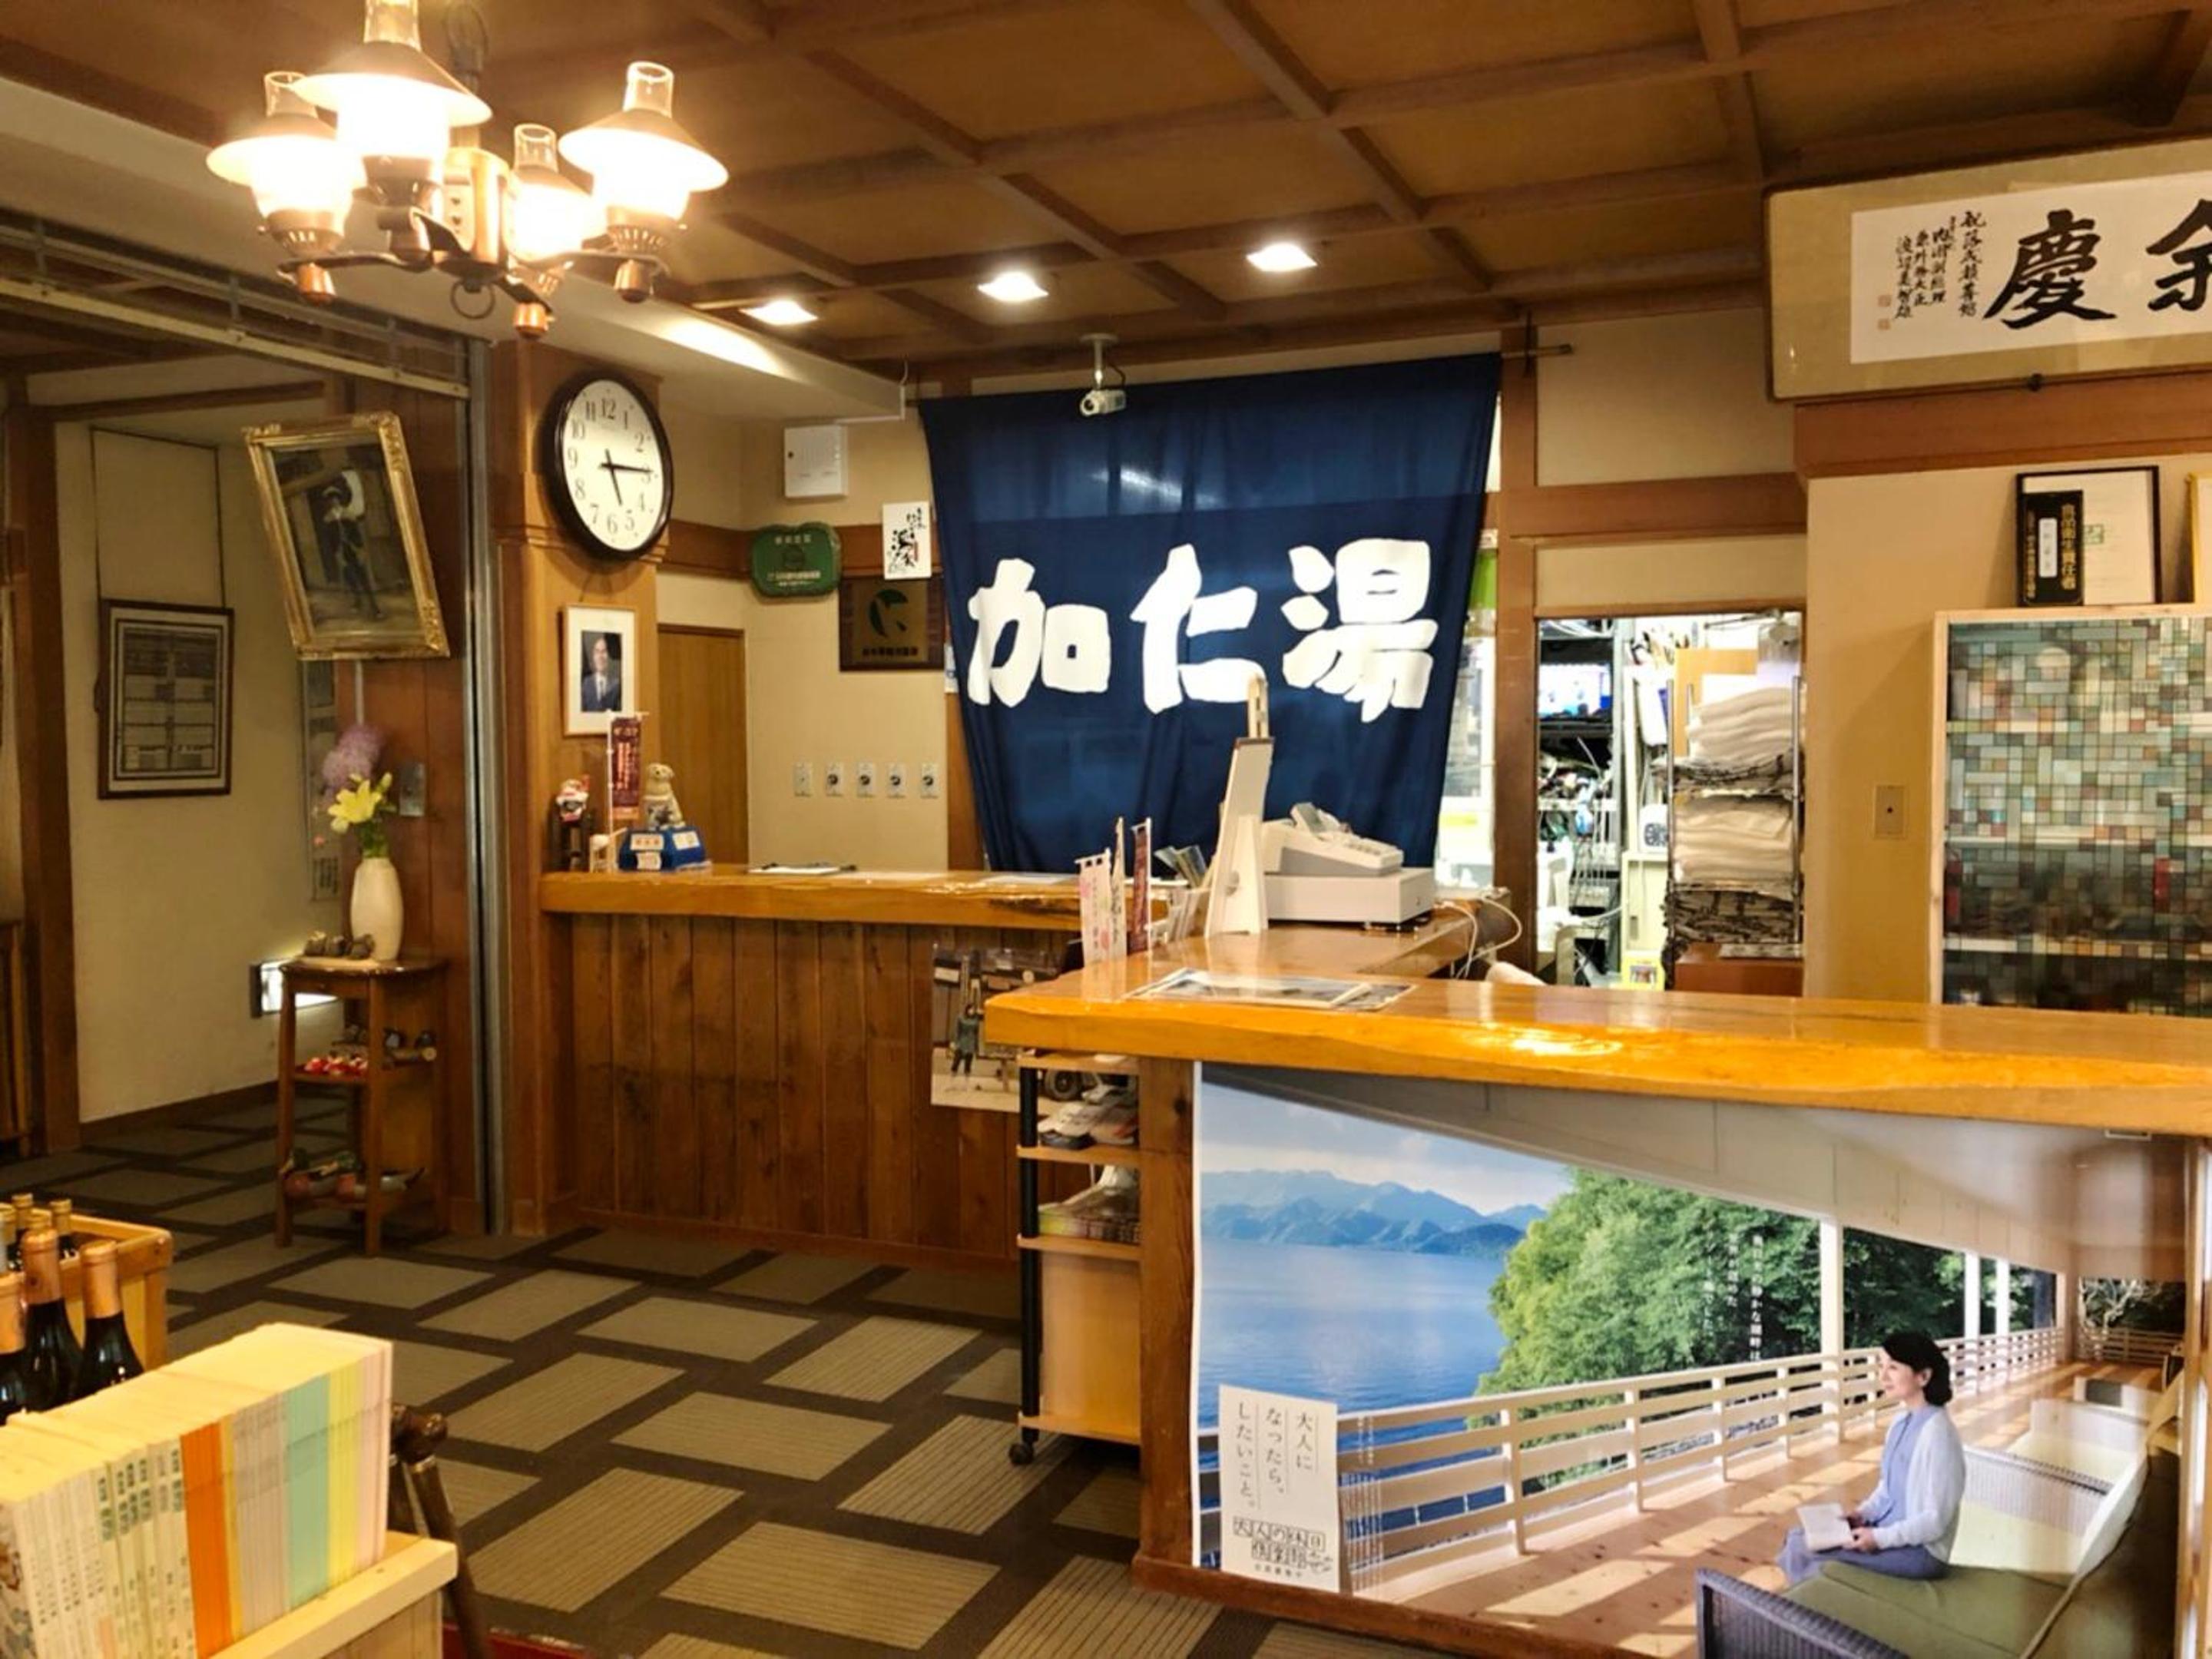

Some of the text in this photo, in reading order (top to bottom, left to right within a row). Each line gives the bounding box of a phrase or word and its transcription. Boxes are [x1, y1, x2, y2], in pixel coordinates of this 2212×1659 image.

[585, 401, 596, 422] 11
[601, 398, 616, 419] 12
[571, 419, 585, 439] 10
[623, 410, 628, 430] 1
[634, 432, 645, 453] 2
[568, 448, 578, 469] 9
[641, 464, 651, 484] 3
[575, 479, 586, 500] 8
[590, 504, 599, 525] 7
[607, 514, 618, 534] 6
[625, 509, 635, 531] 5
[967, 537, 1439, 724] 加仁湯
[1296, 1411, 1313, 1471] 大人に
[1236, 1402, 1256, 1507] したいこと。
